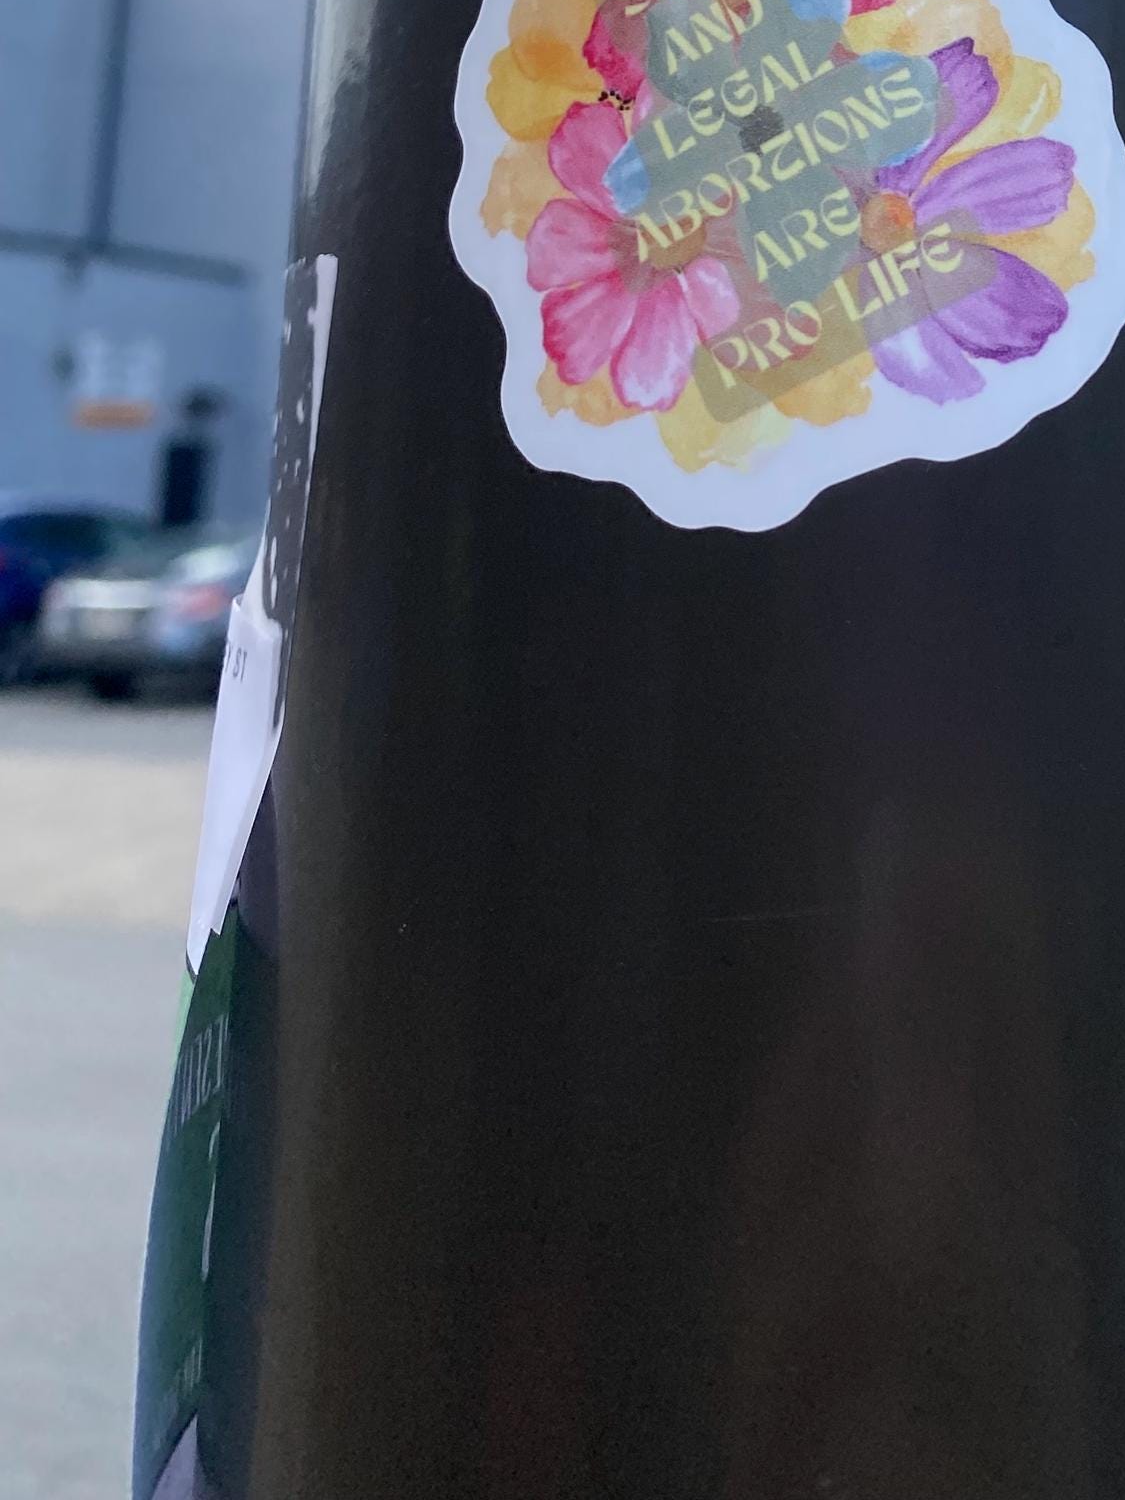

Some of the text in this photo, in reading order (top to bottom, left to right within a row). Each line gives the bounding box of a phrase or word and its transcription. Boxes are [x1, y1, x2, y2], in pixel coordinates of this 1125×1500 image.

[652, 40, 834, 162] LEGAL
[635, 65, 925, 264] ABORTIONS
[752, 185, 862, 284] ARE
